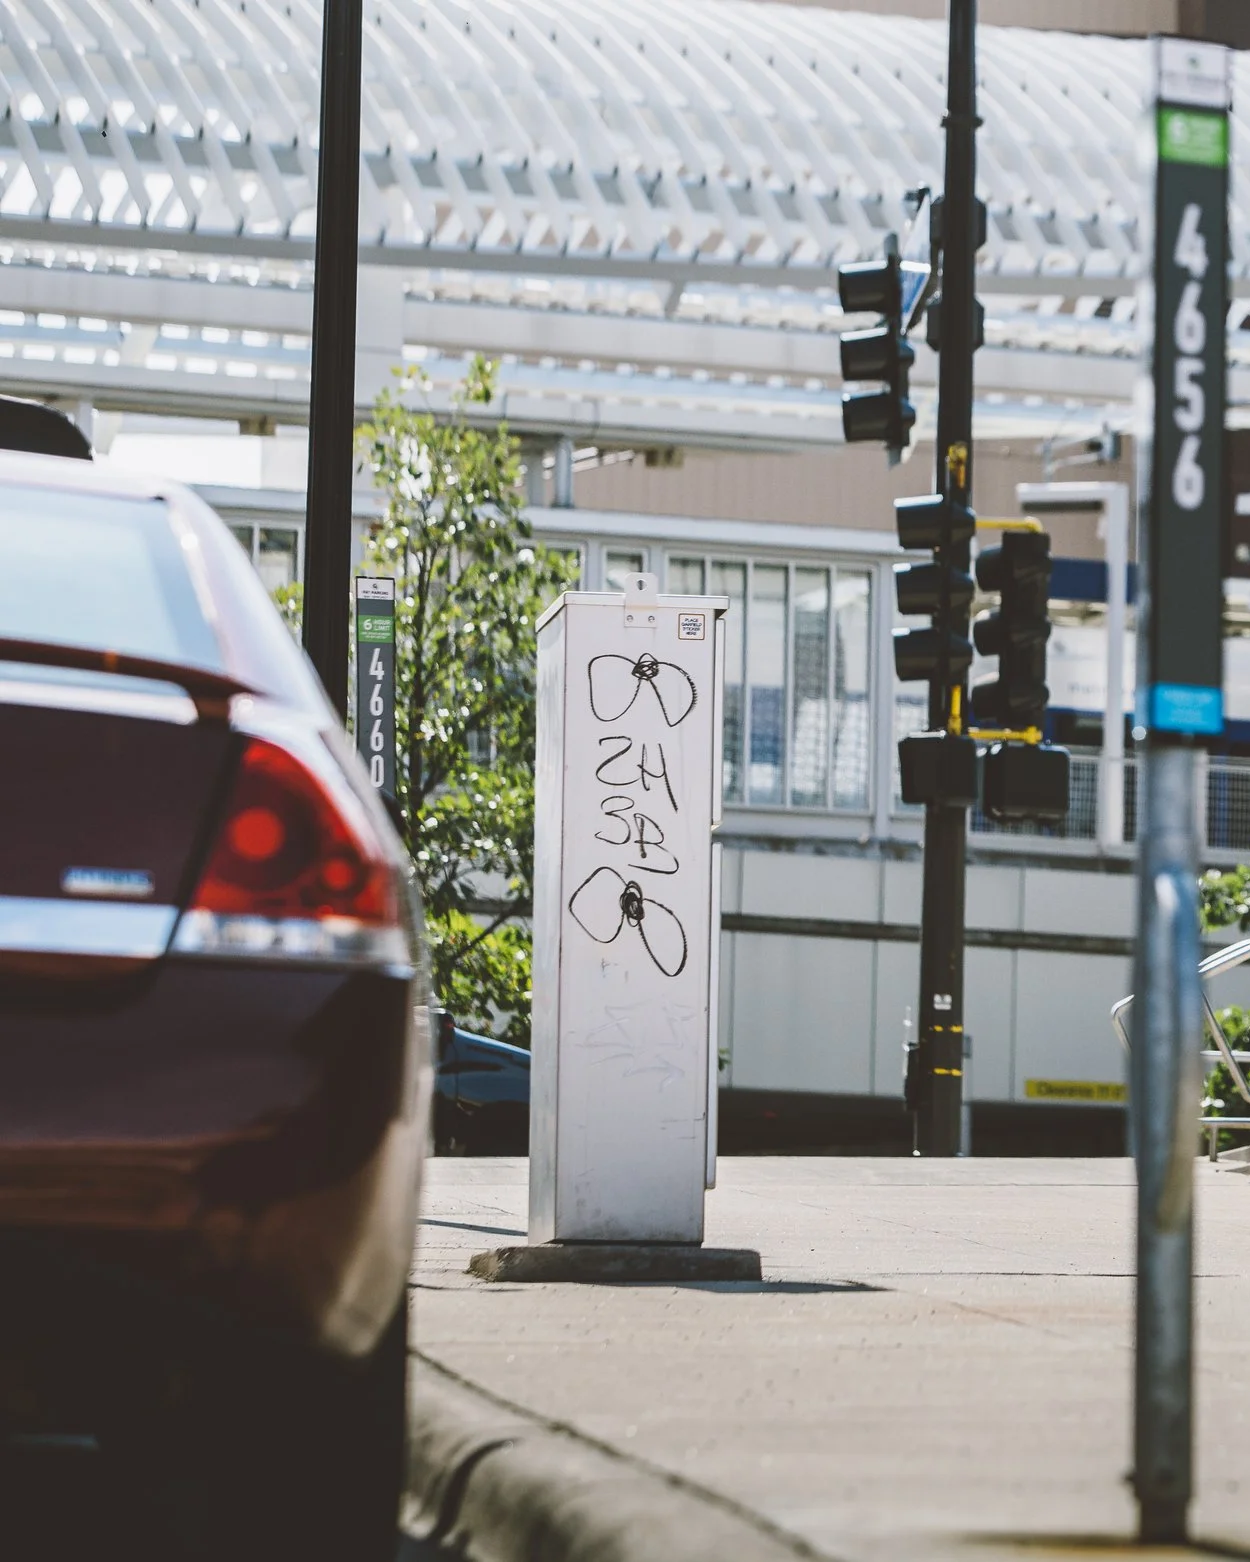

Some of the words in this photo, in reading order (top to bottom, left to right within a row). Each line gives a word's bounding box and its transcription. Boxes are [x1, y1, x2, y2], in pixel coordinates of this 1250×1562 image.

[1172, 202, 1209, 511] 4656
[363, 618, 373, 630] 6
[369, 647, 385, 788] 4660
